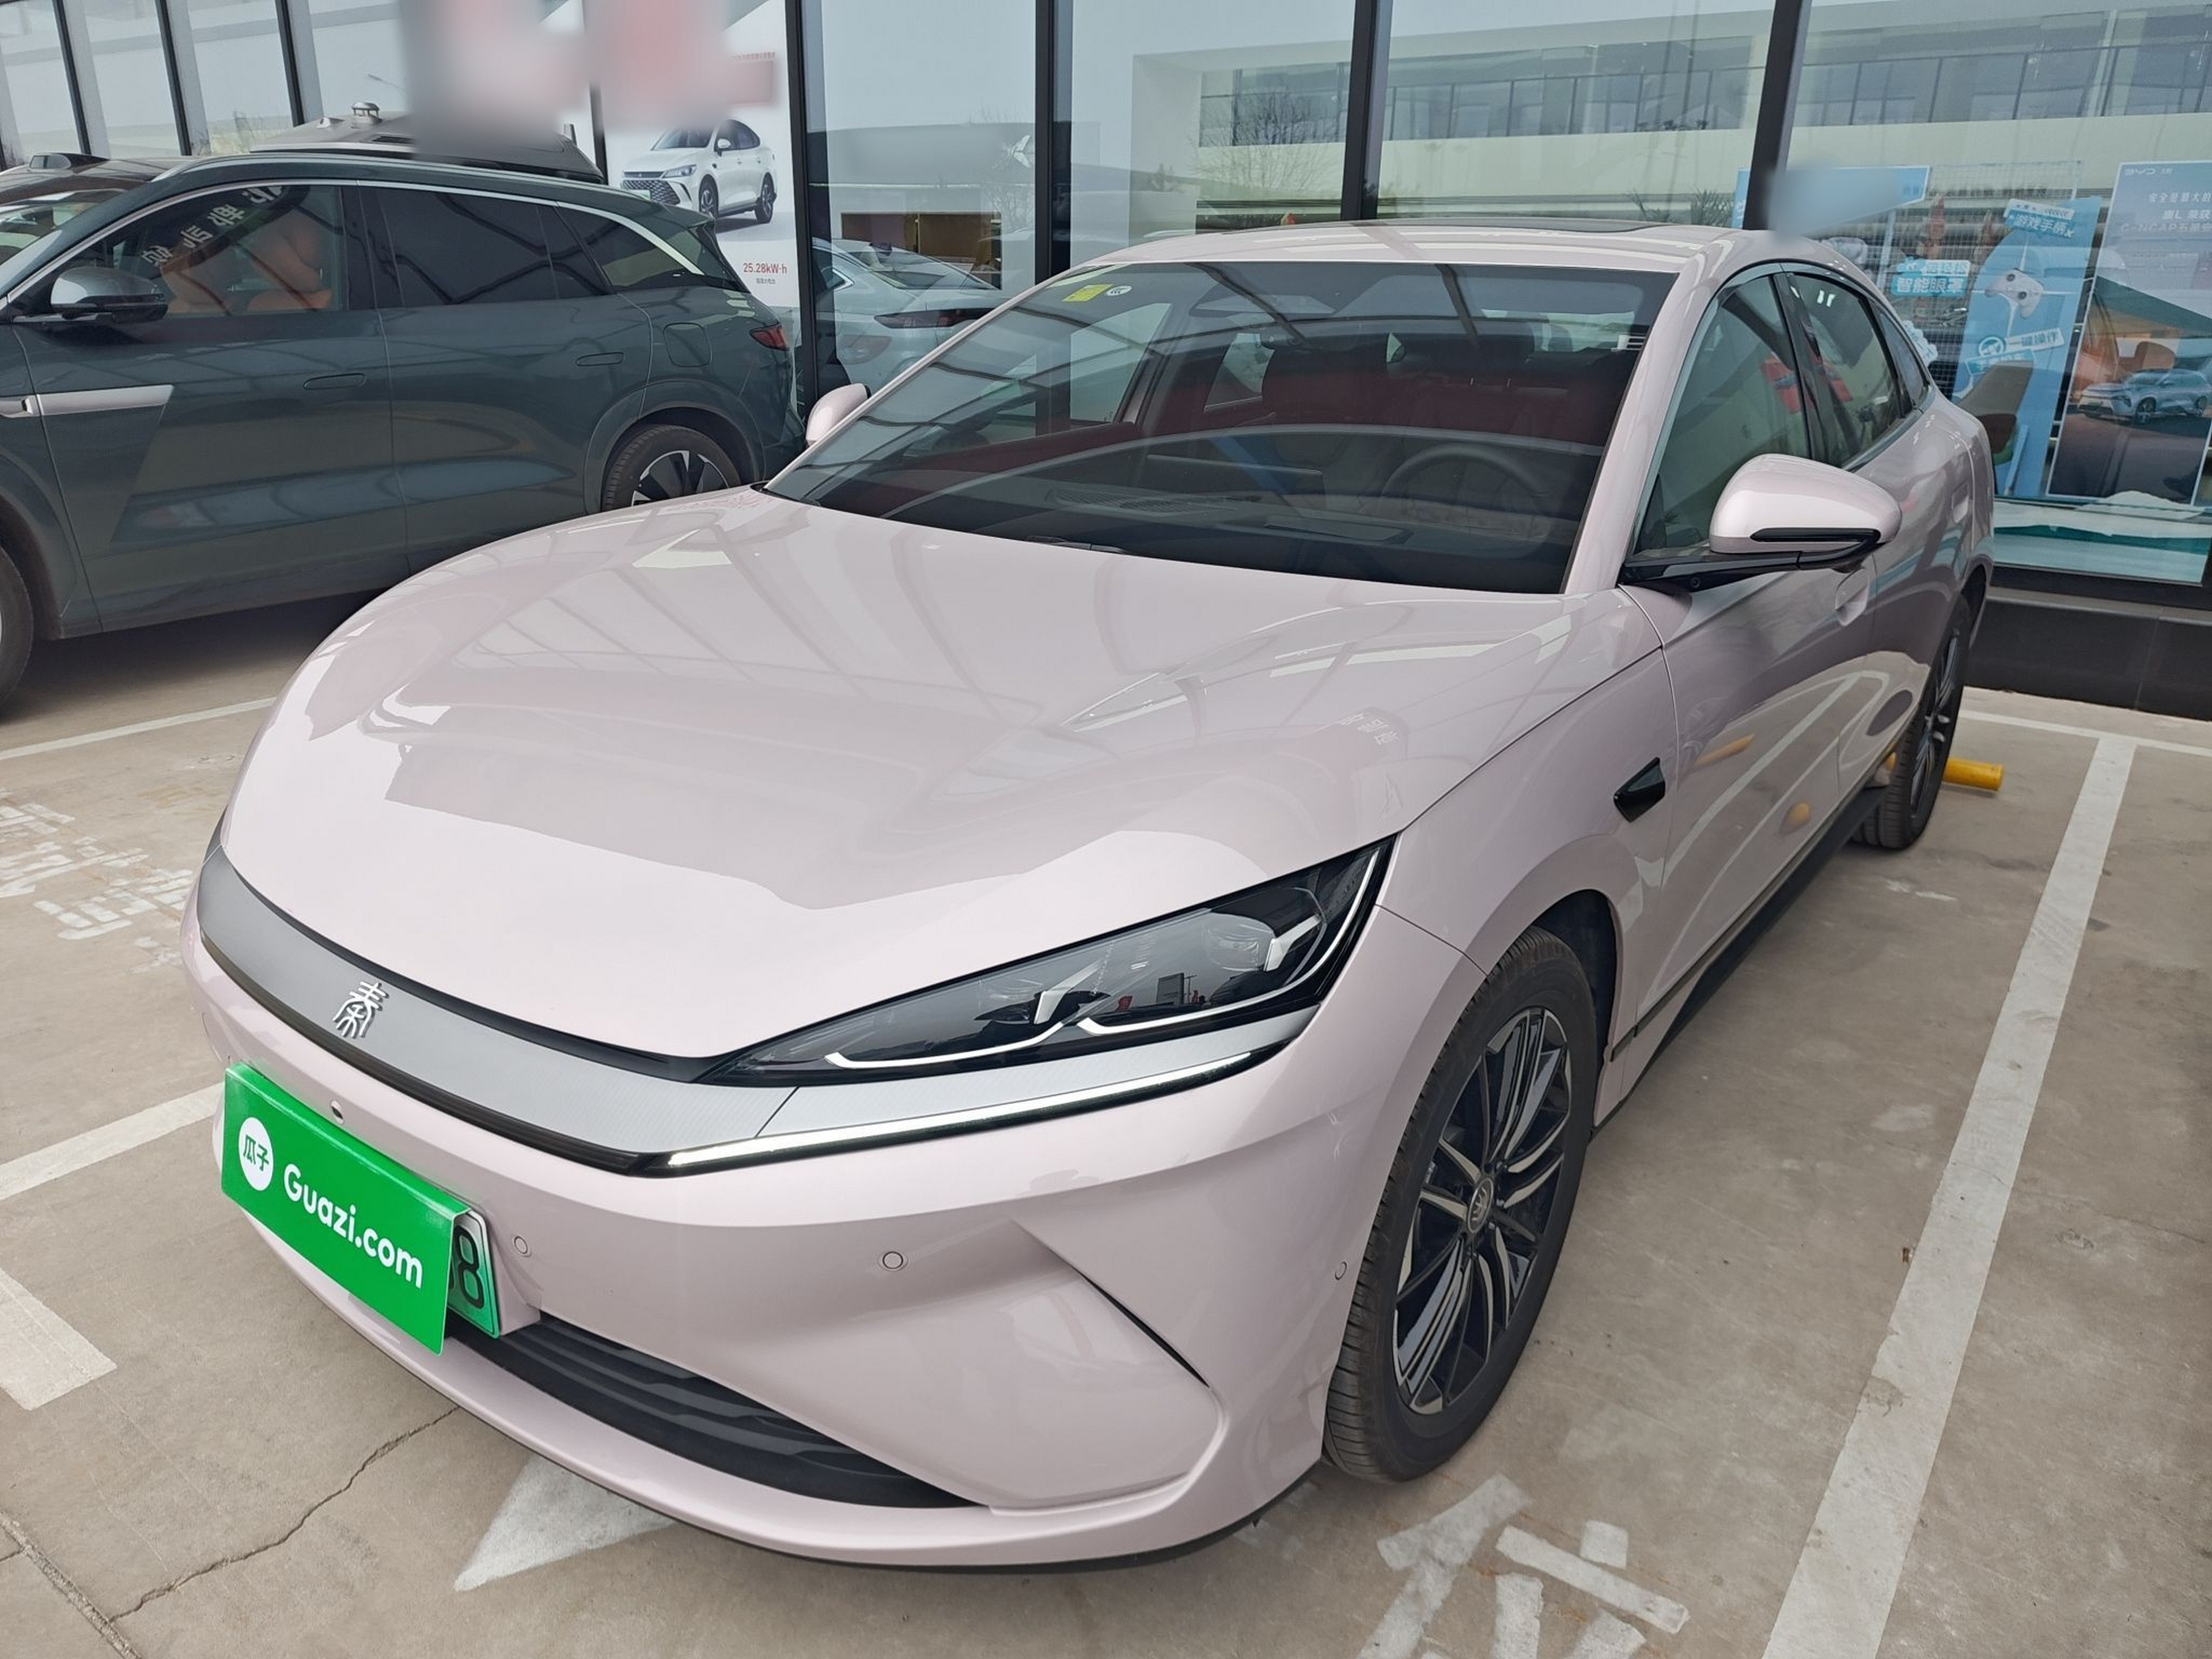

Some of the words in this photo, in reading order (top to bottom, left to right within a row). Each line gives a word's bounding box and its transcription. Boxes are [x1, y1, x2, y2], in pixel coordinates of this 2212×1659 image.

[1896, 277, 1963, 293] 智能眼罩
[243, 1135, 270, 1173] 瓜子
[283, 1162, 423, 1289] Guazi.com
